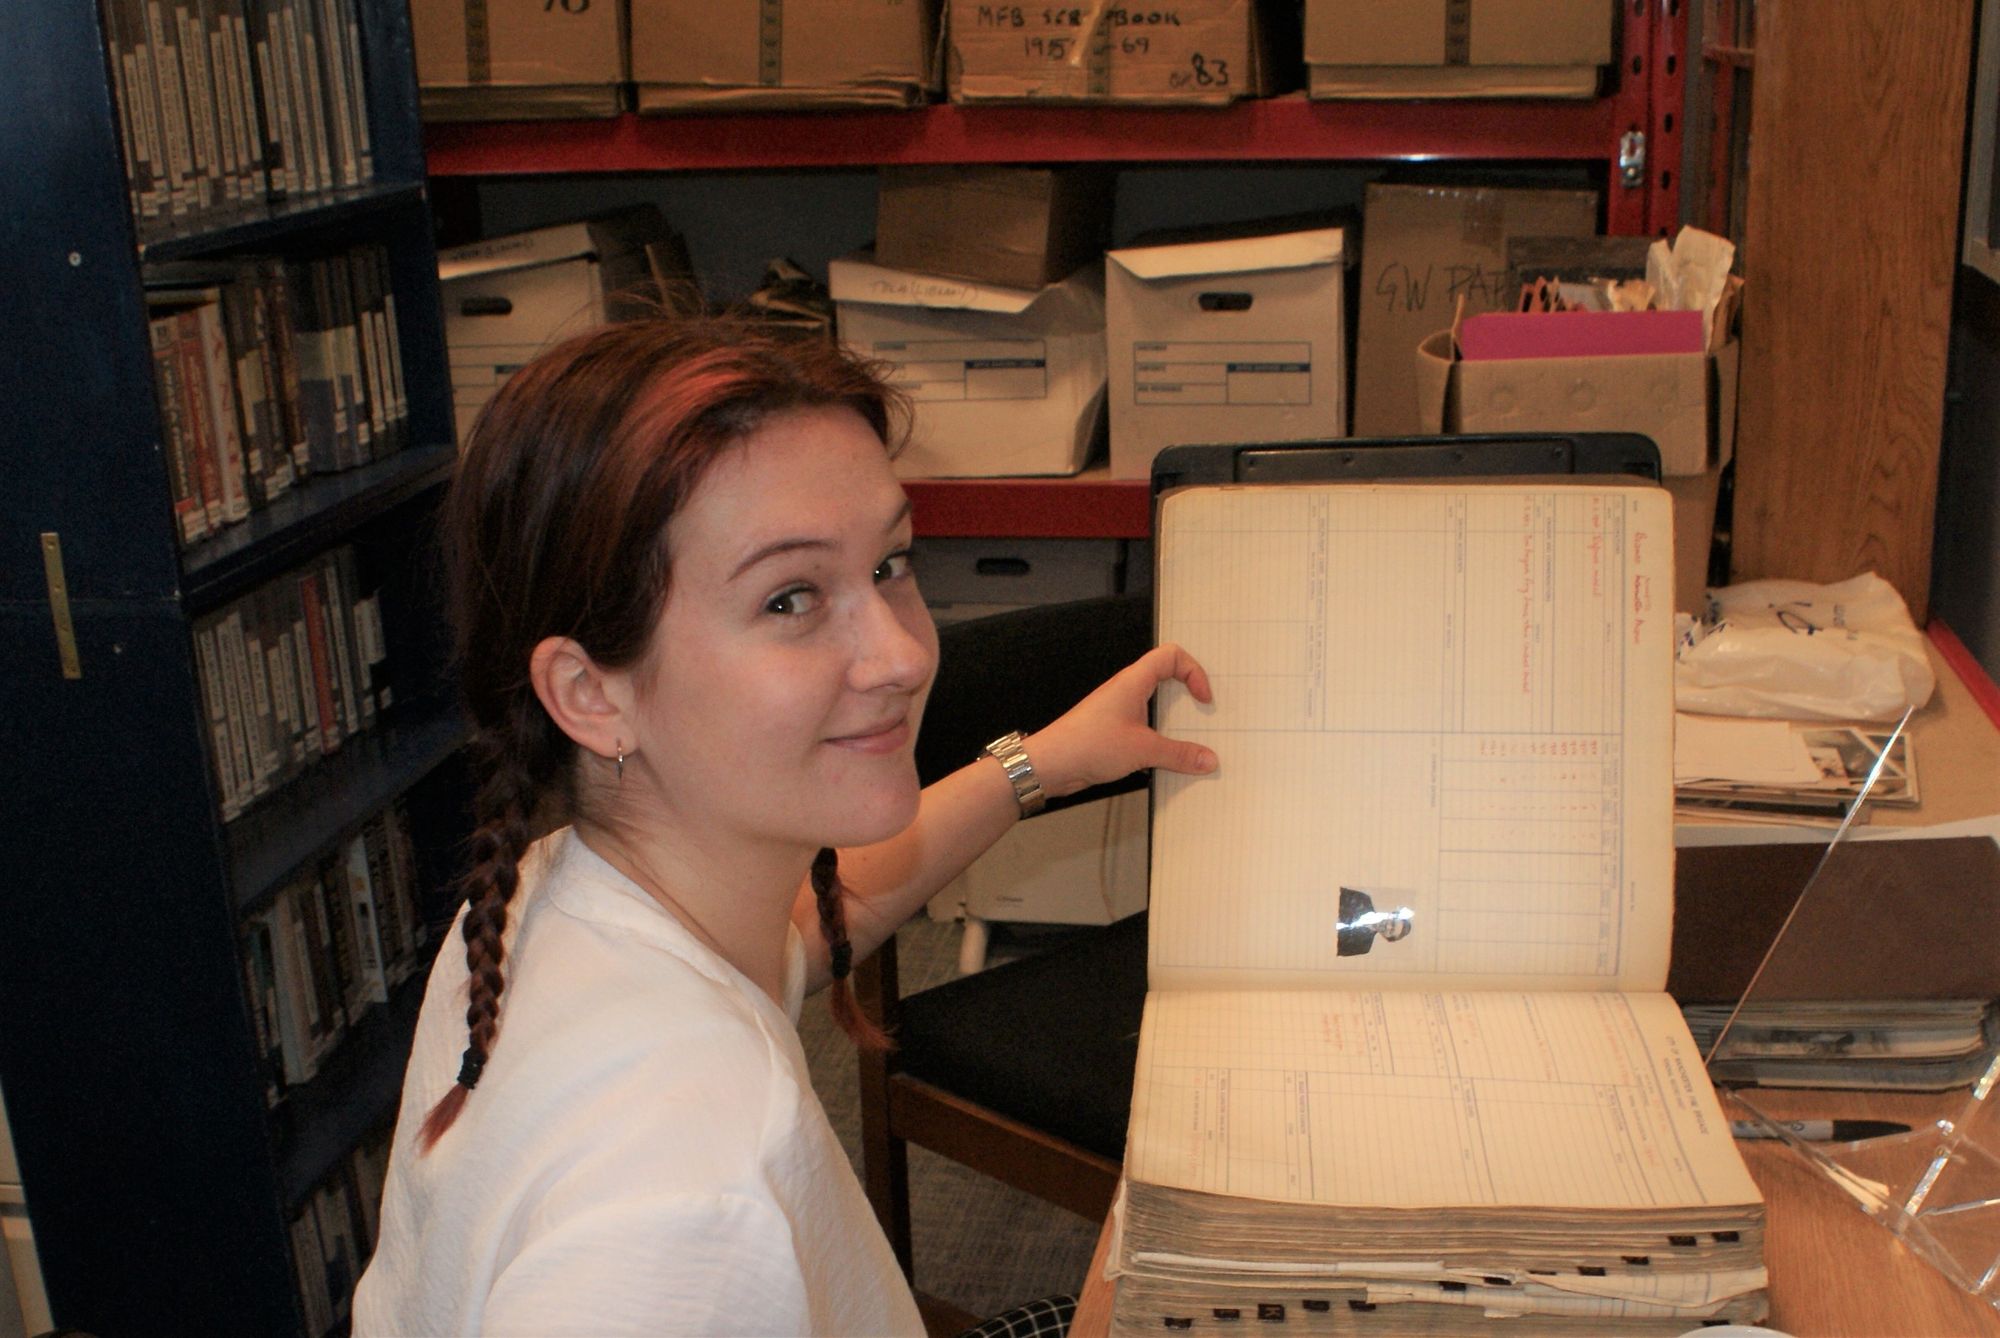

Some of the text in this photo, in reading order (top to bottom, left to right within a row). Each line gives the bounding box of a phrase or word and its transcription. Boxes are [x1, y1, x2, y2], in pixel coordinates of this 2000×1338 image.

[977, 6, 1025, 27] MFB
[1191, 53, 1230, 87] 83
[1376, 262, 1433, 313] GW
